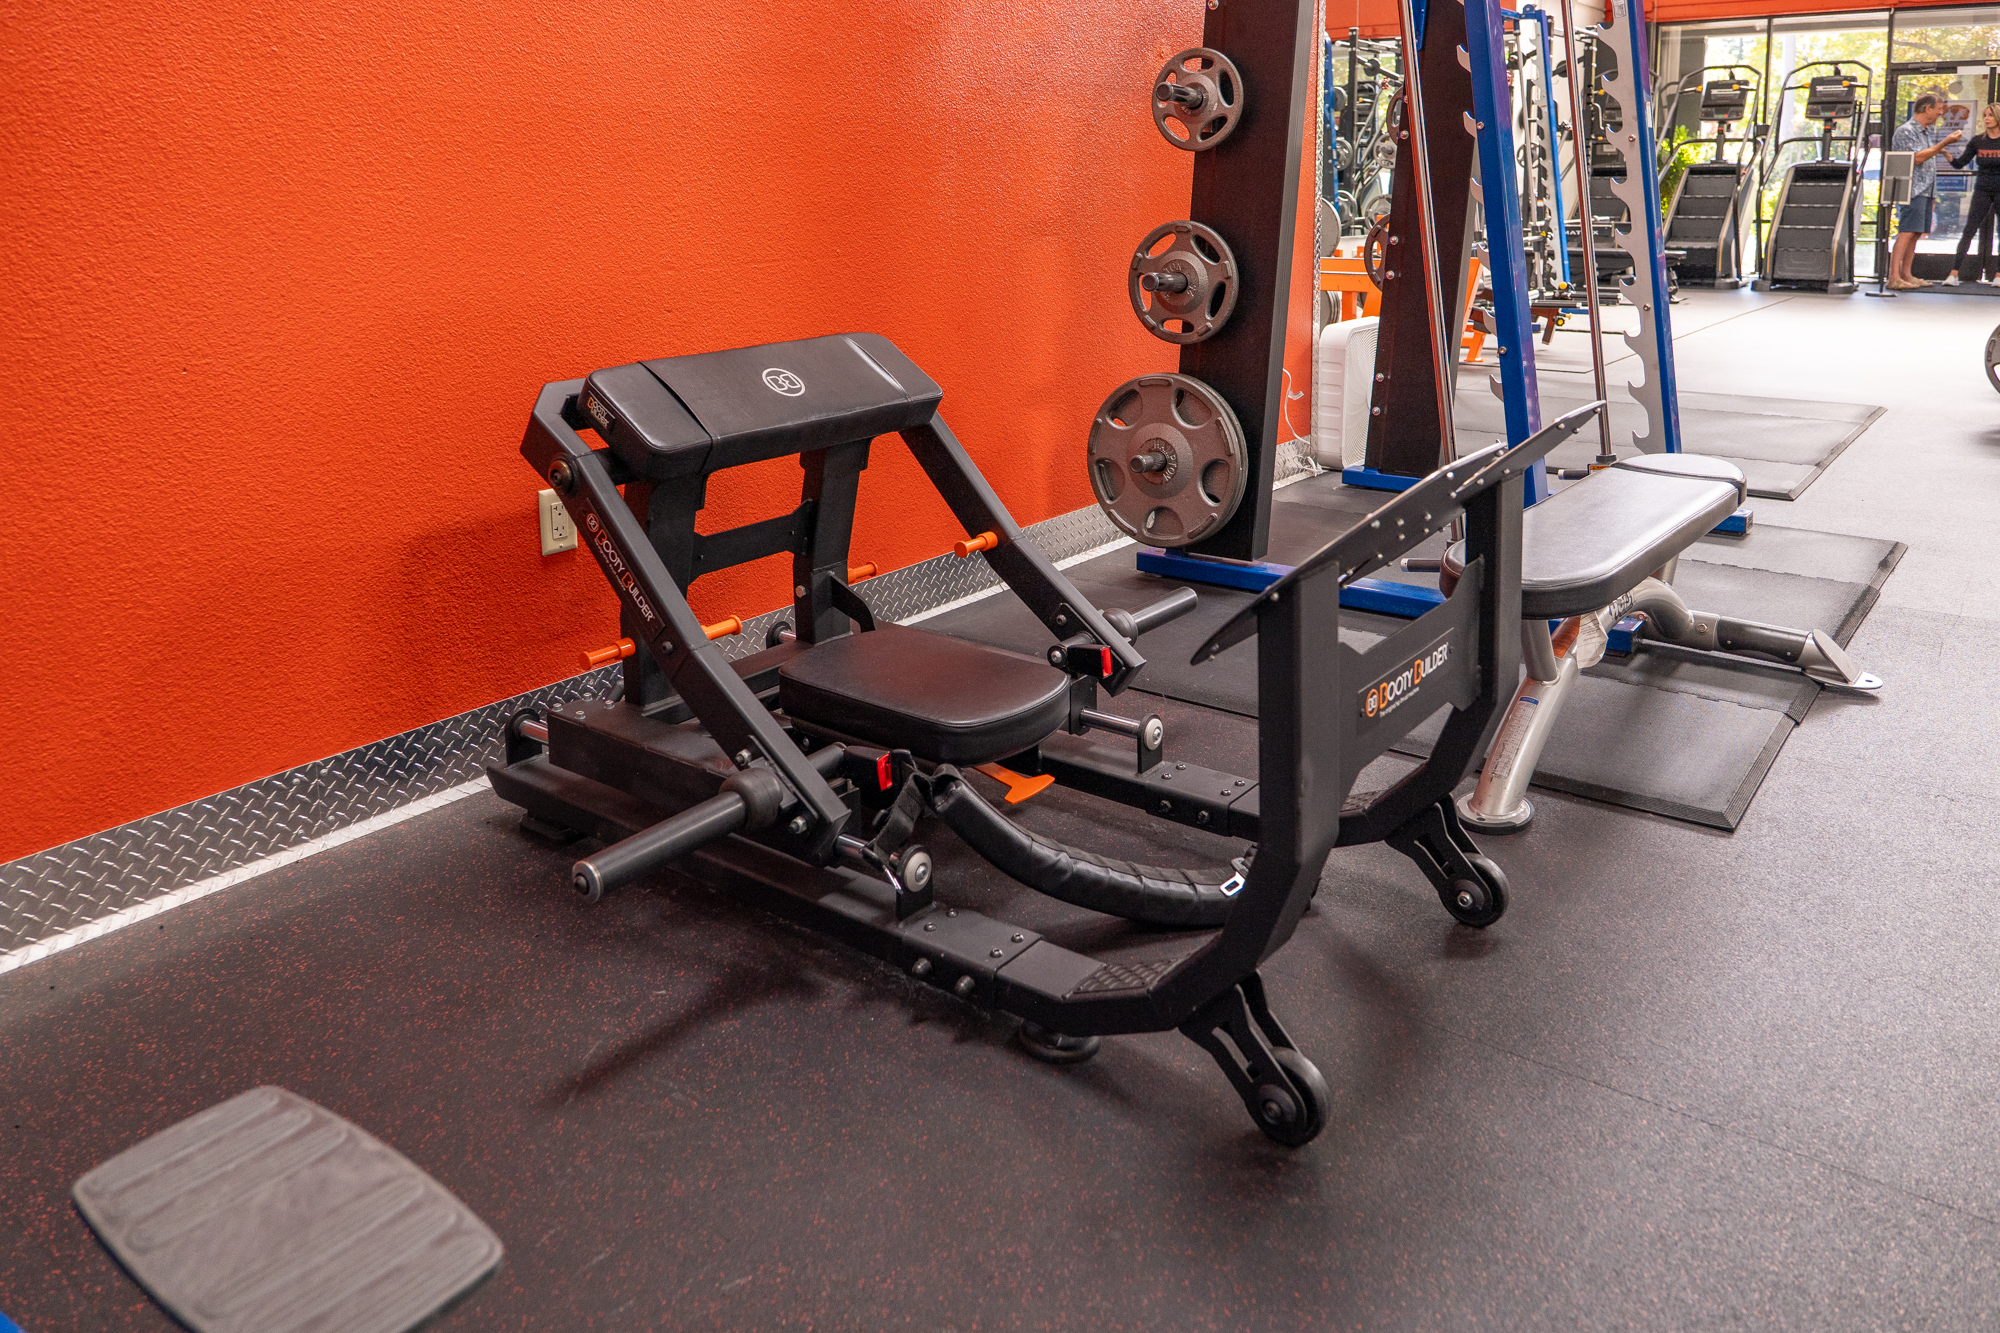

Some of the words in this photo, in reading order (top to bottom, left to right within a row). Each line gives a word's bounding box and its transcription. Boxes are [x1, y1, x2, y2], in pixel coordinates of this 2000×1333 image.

[596, 529, 626, 573] BOOTY
[621, 571, 654, 622] BUILDER
[1379, 668, 1414, 709] BOOTY
[1414, 643, 1448, 685] BUILDER
